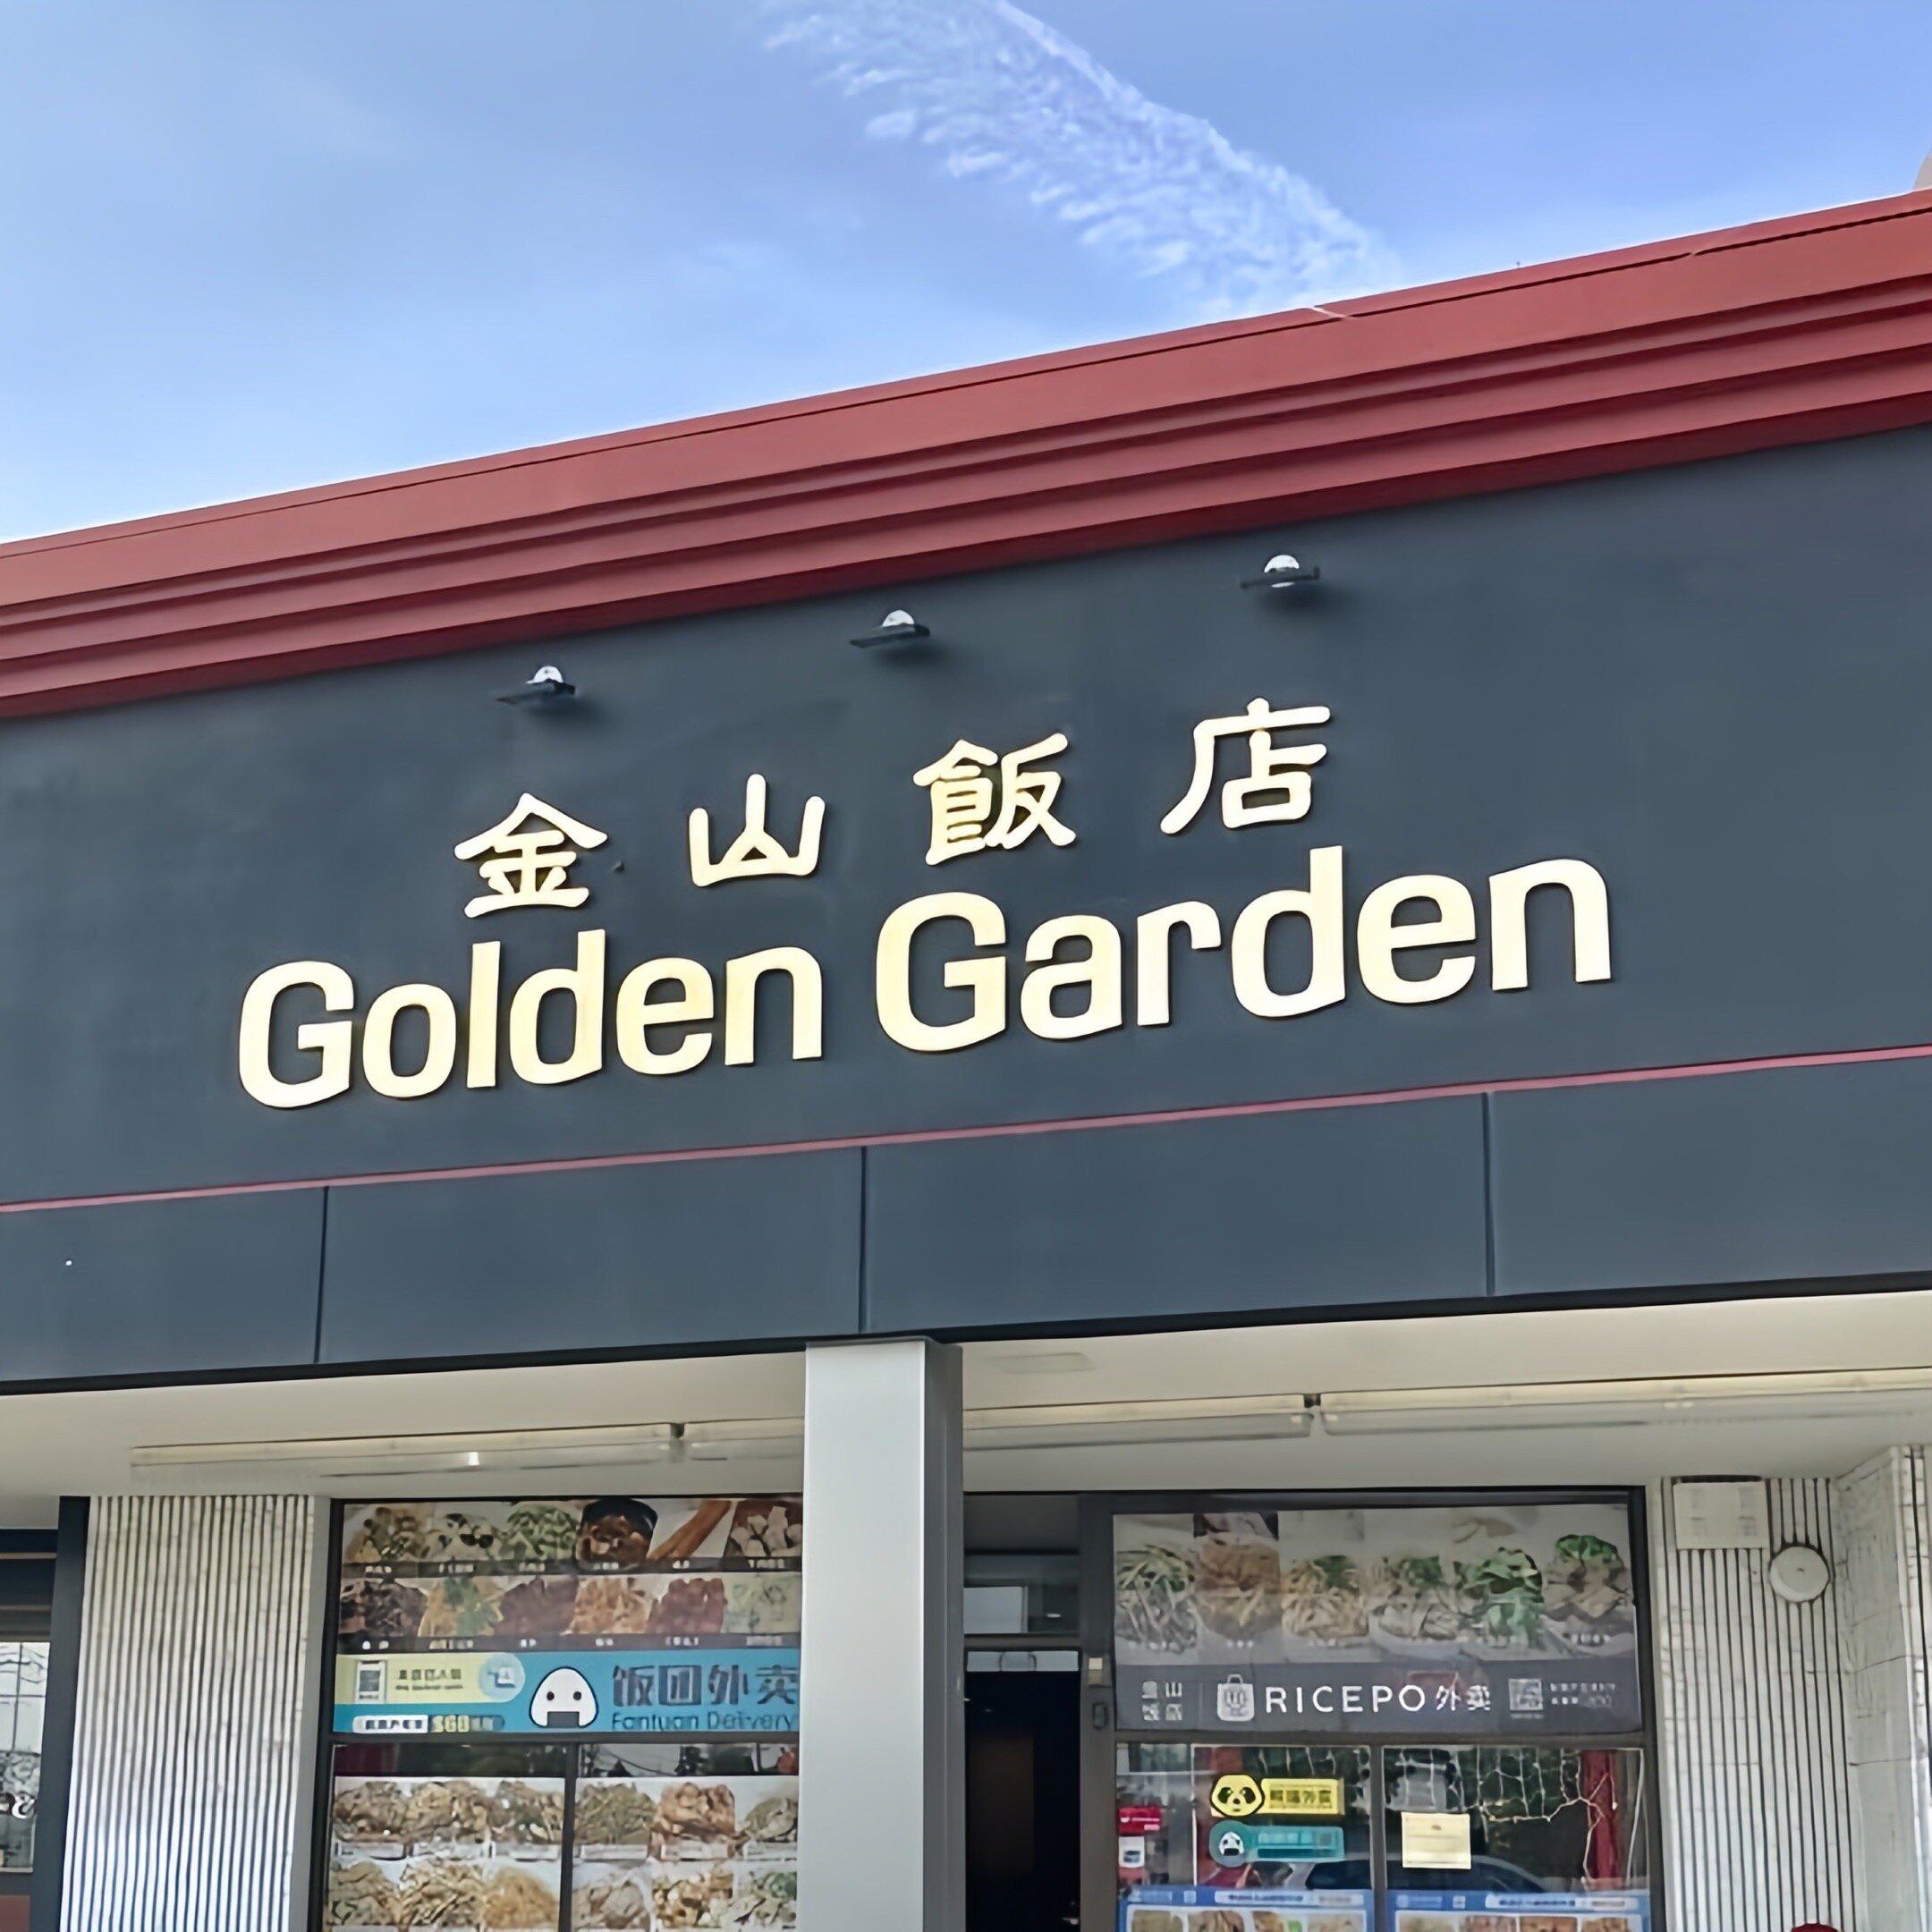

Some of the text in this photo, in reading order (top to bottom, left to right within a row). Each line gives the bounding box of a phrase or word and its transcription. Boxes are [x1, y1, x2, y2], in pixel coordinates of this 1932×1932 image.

[454, 697, 1331, 919] 金山飯店
[238, 844, 1612, 1109] Golden Garden
[1265, 1684, 1426, 1714] RICEPO
